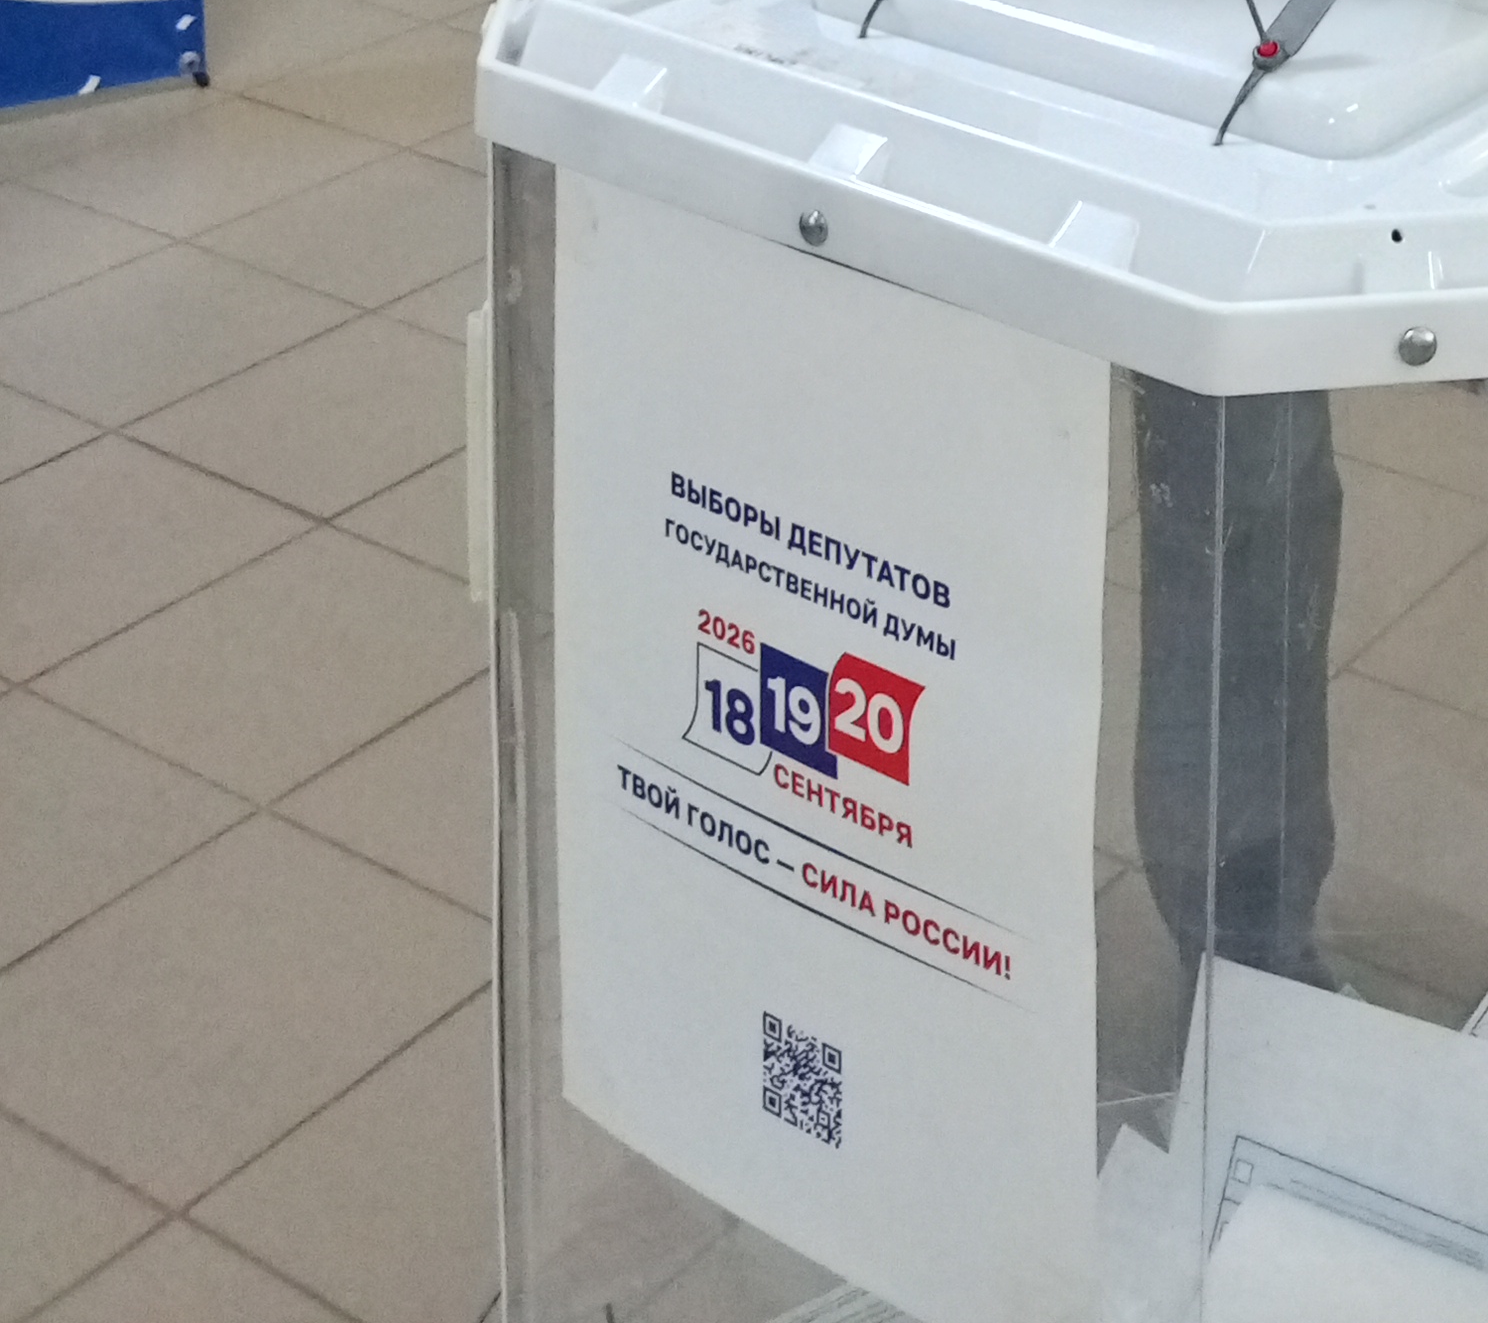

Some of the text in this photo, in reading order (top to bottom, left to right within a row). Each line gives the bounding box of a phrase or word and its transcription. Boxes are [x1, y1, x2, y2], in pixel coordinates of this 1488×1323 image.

[665, 518, 956, 660] ГОСУДАРСТВЕННОЙ ДУМЫ
[671, 471, 951, 609] ВЫБОРЫ ДЕПУТАТОВ
[698, 609, 756, 655] 2026
[705, 676, 904, 754] 18 19 20
[774, 763, 913, 848] СЕНТЯБРЯ
[617, 764, 680, 820] ТВОЙ
[687, 804, 770, 865] ГОЛОС
[802, 862, 876, 917] СИЛА
[884, 899, 1012, 981] РОССИИ!
